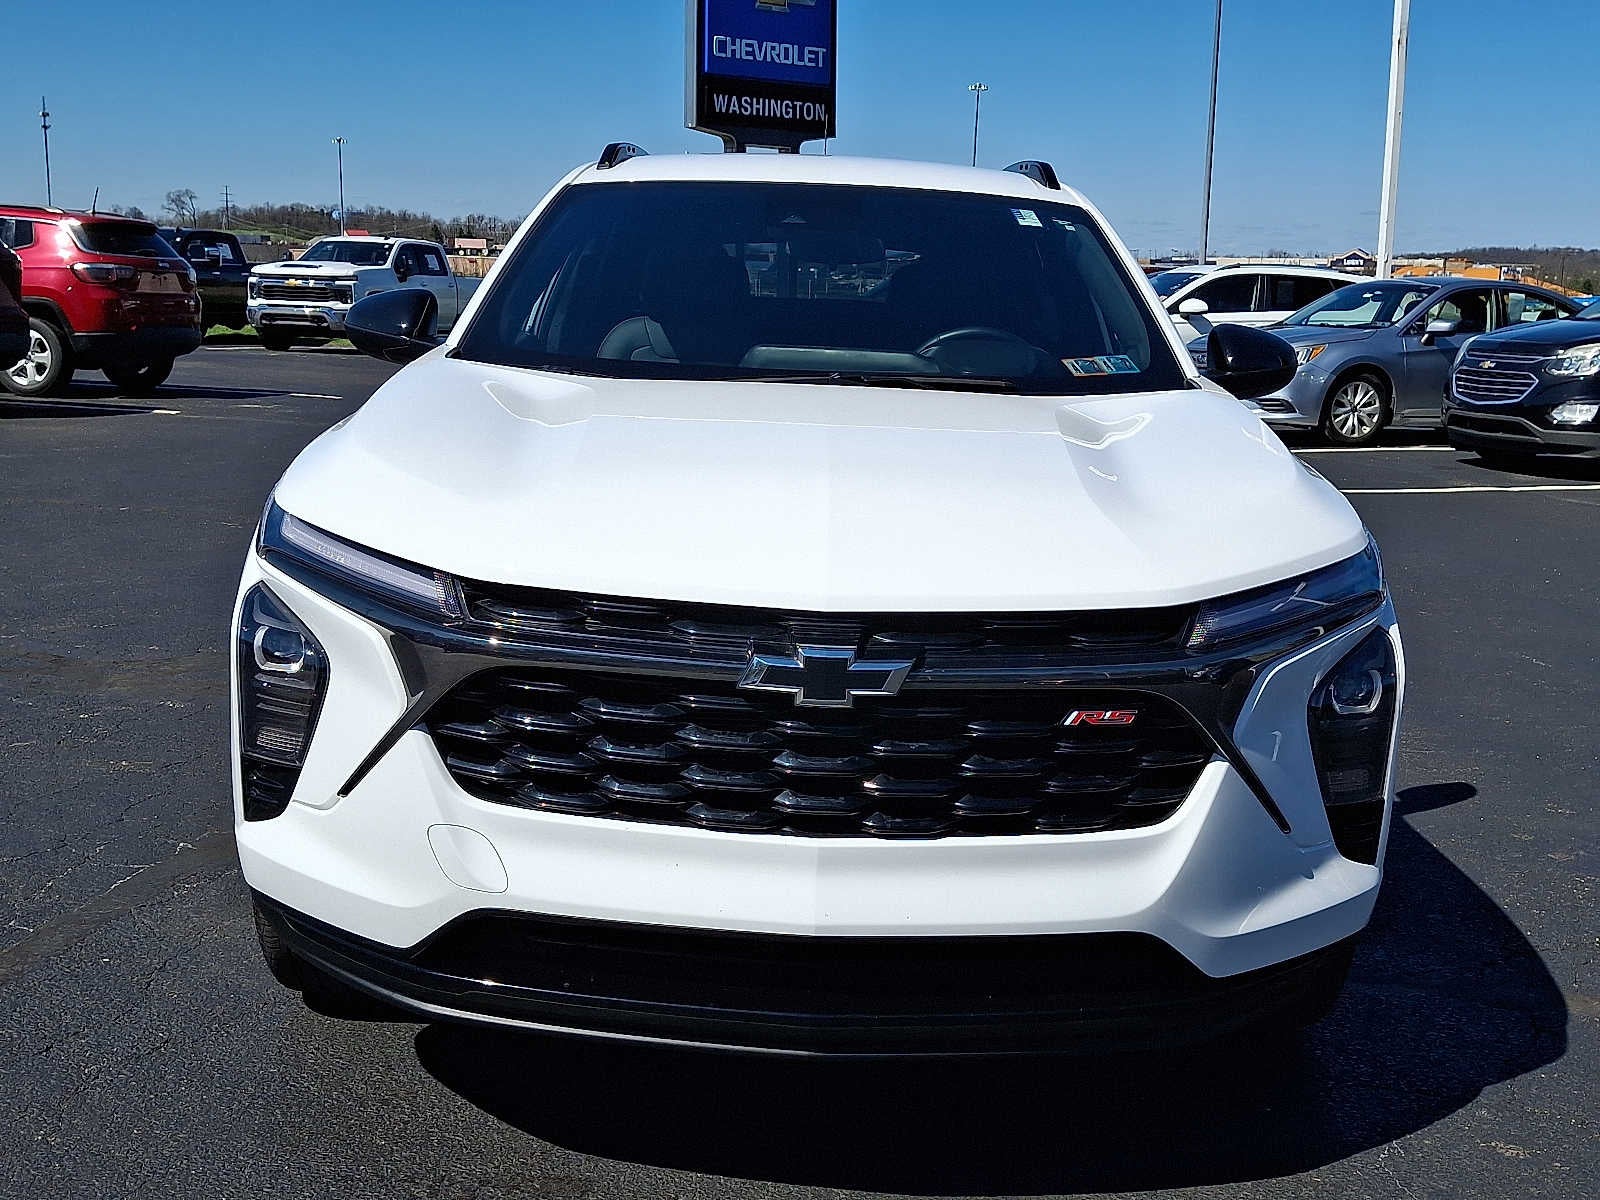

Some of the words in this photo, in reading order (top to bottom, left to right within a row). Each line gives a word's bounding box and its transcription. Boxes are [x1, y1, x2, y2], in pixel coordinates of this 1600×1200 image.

[713, 35, 826, 67] CHEVROLET
[713, 93, 825, 121] WASHINGTON
[1063, 710, 1138, 726] RS
